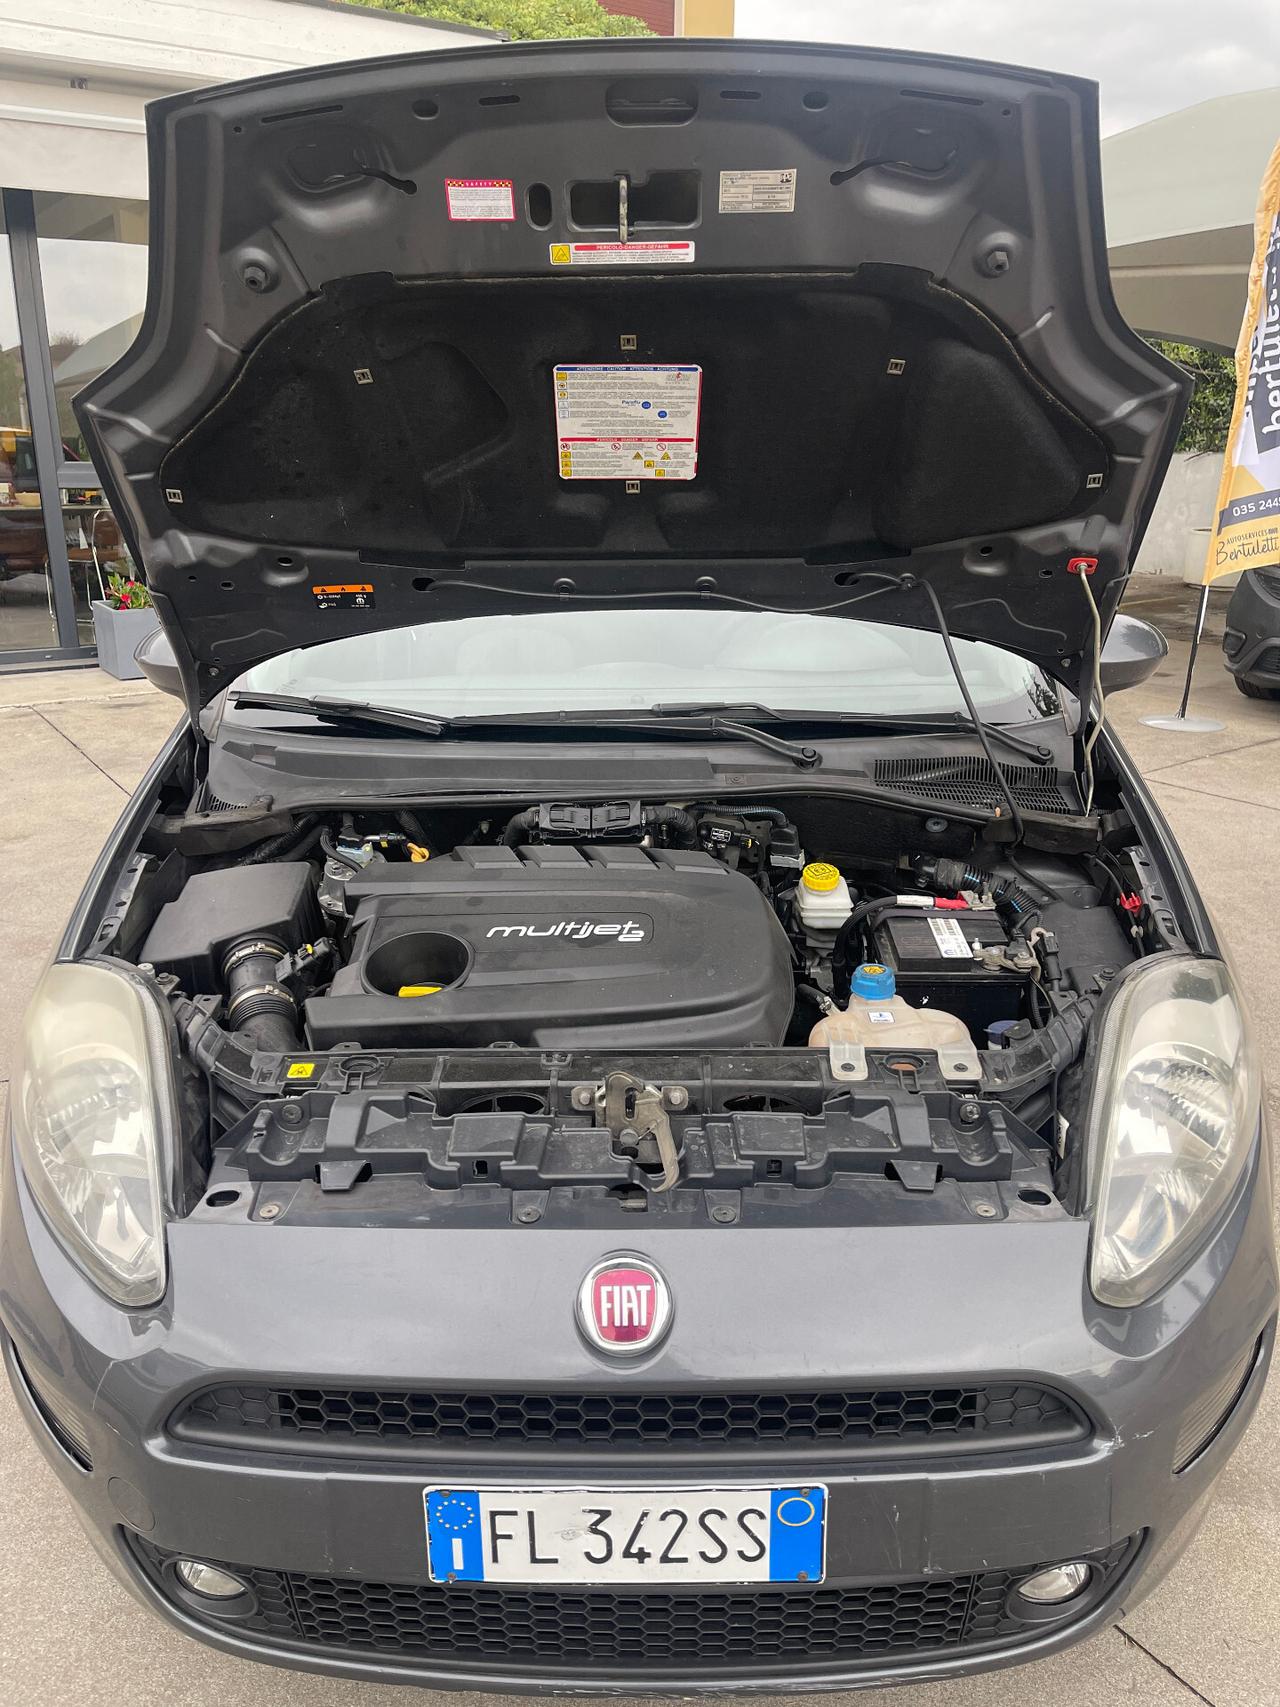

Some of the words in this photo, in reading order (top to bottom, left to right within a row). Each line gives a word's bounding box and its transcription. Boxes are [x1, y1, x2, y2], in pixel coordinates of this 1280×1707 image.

[1232, 502, 1256, 517] 035
[1226, 530, 1269, 545] AUTOSERVICES
[1215, 536, 1280, 566] Bertuletti
[600, 1285, 651, 1328] FIAT
